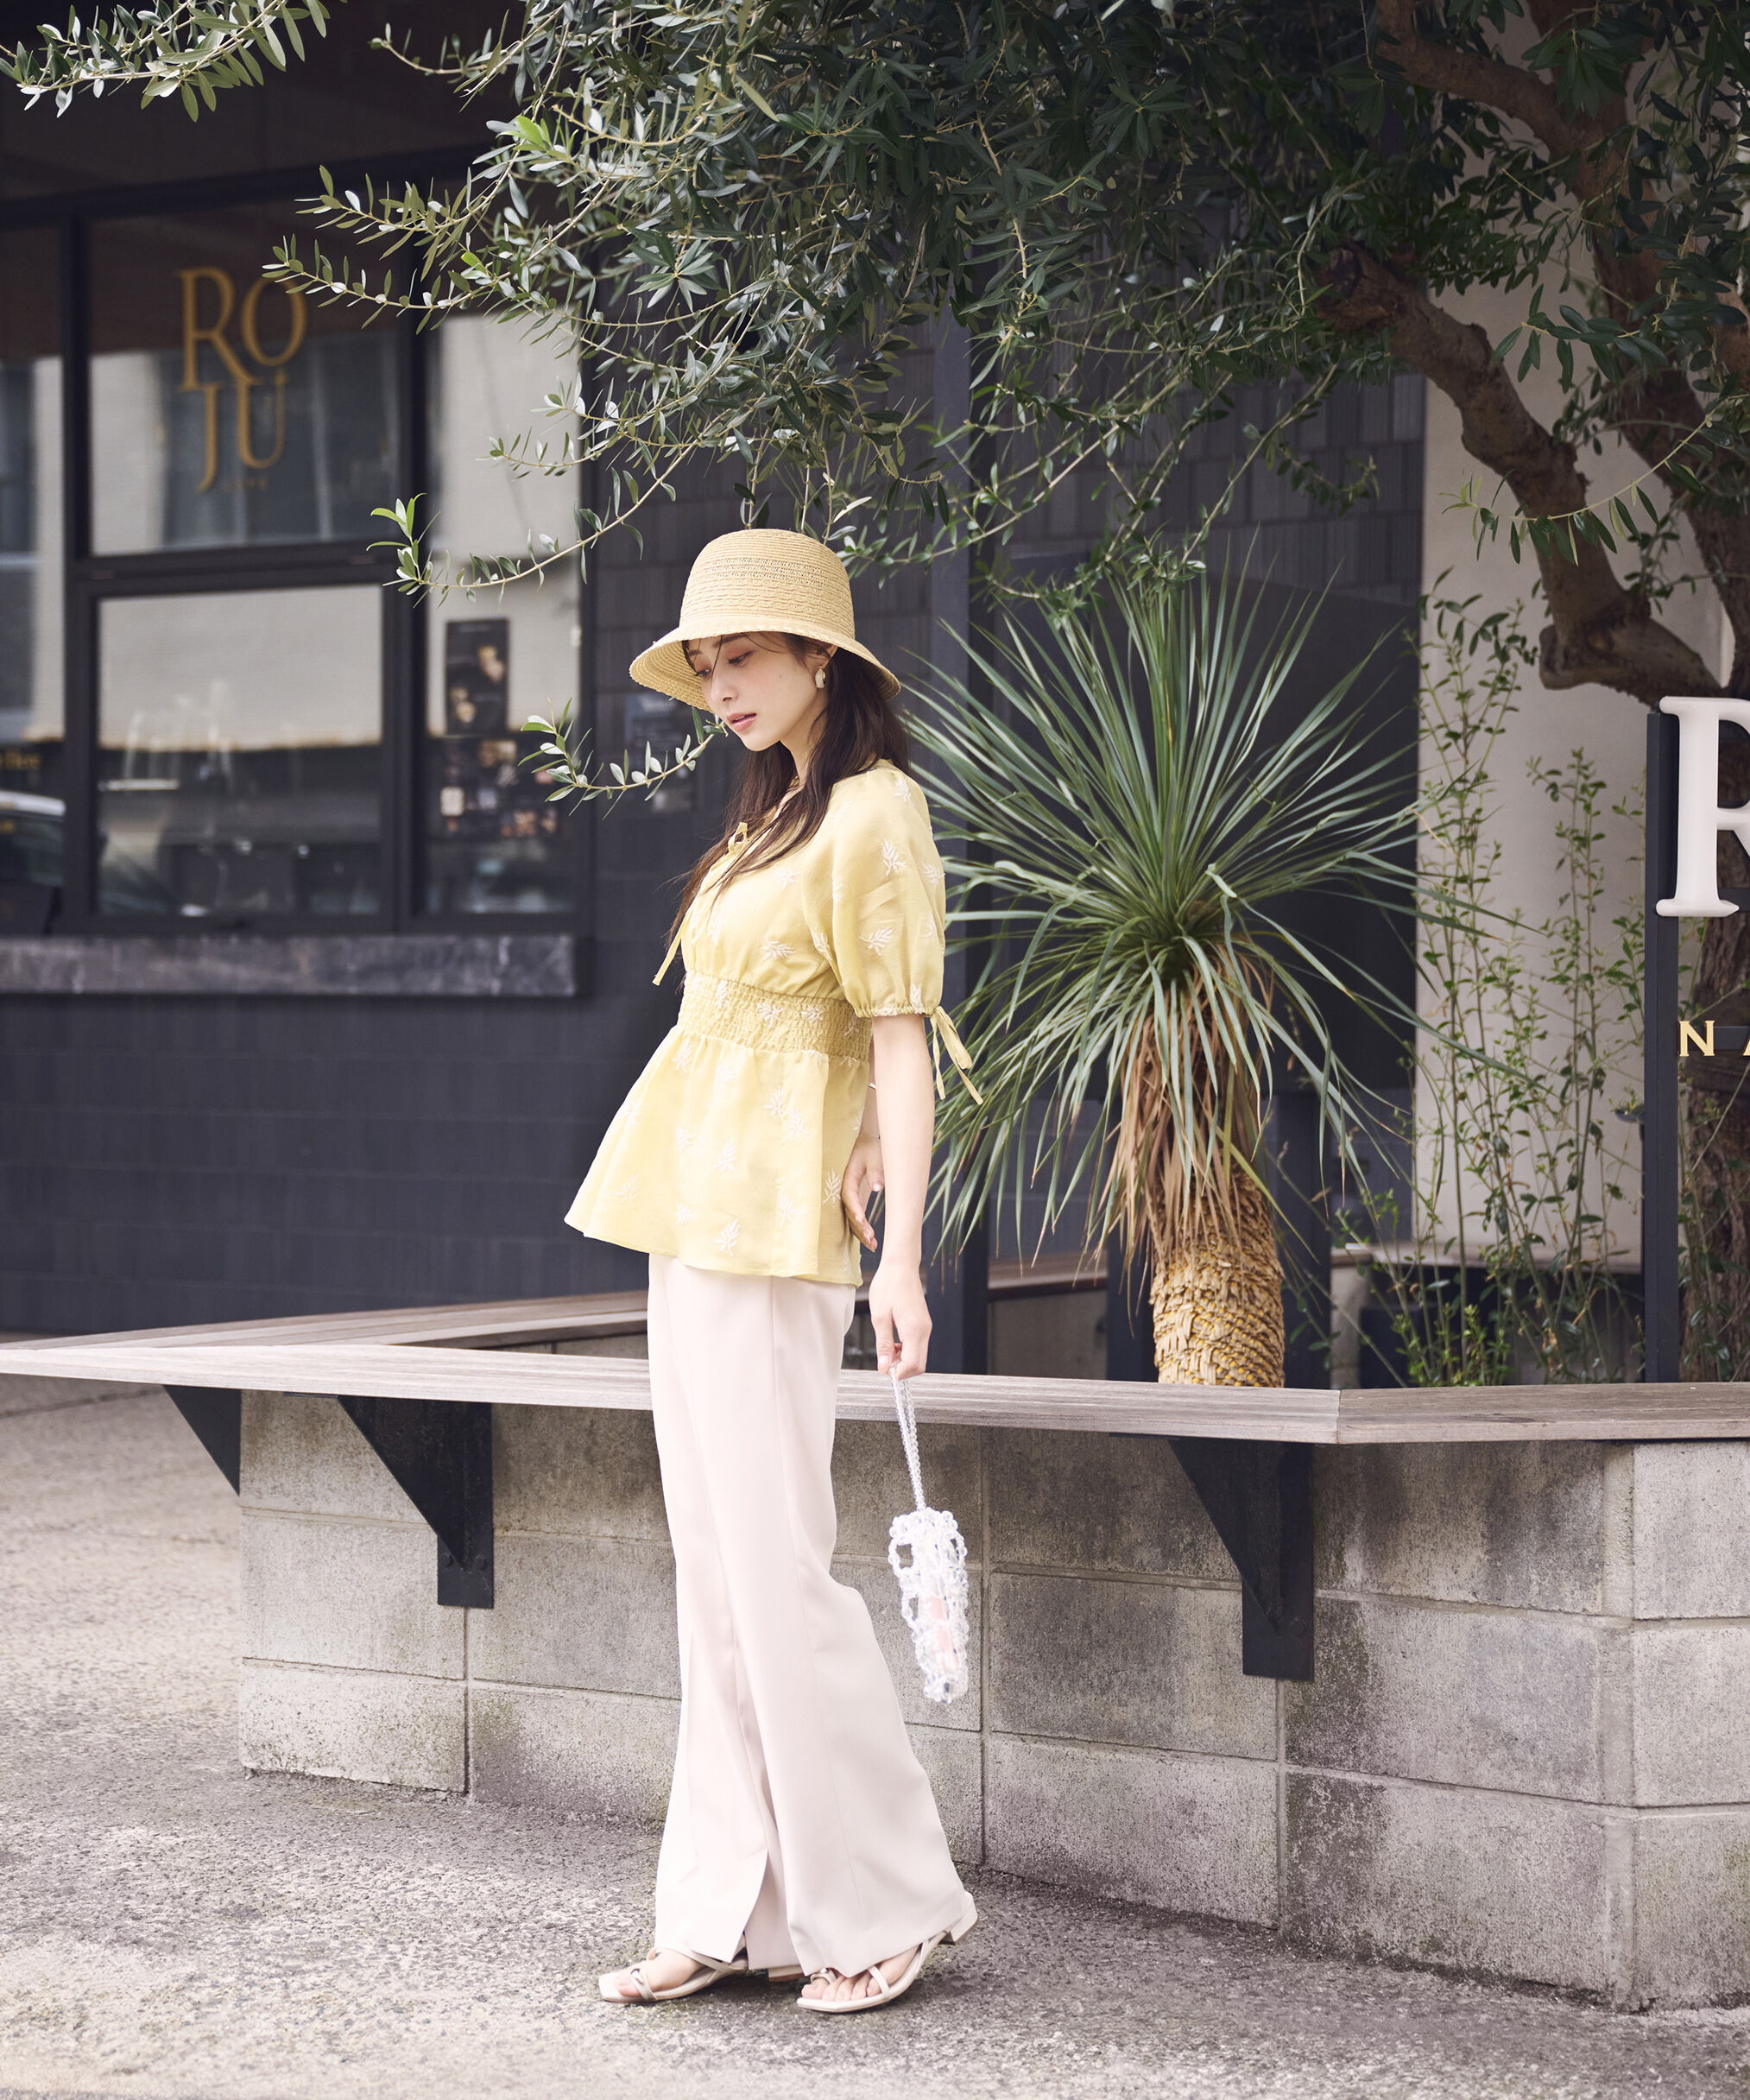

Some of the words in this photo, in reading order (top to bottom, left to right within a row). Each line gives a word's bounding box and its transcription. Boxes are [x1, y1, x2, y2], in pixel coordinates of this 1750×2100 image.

[178, 267, 306, 391] RO
[197, 372, 287, 492] JU
[1678, 1020, 1750, 1057] N
